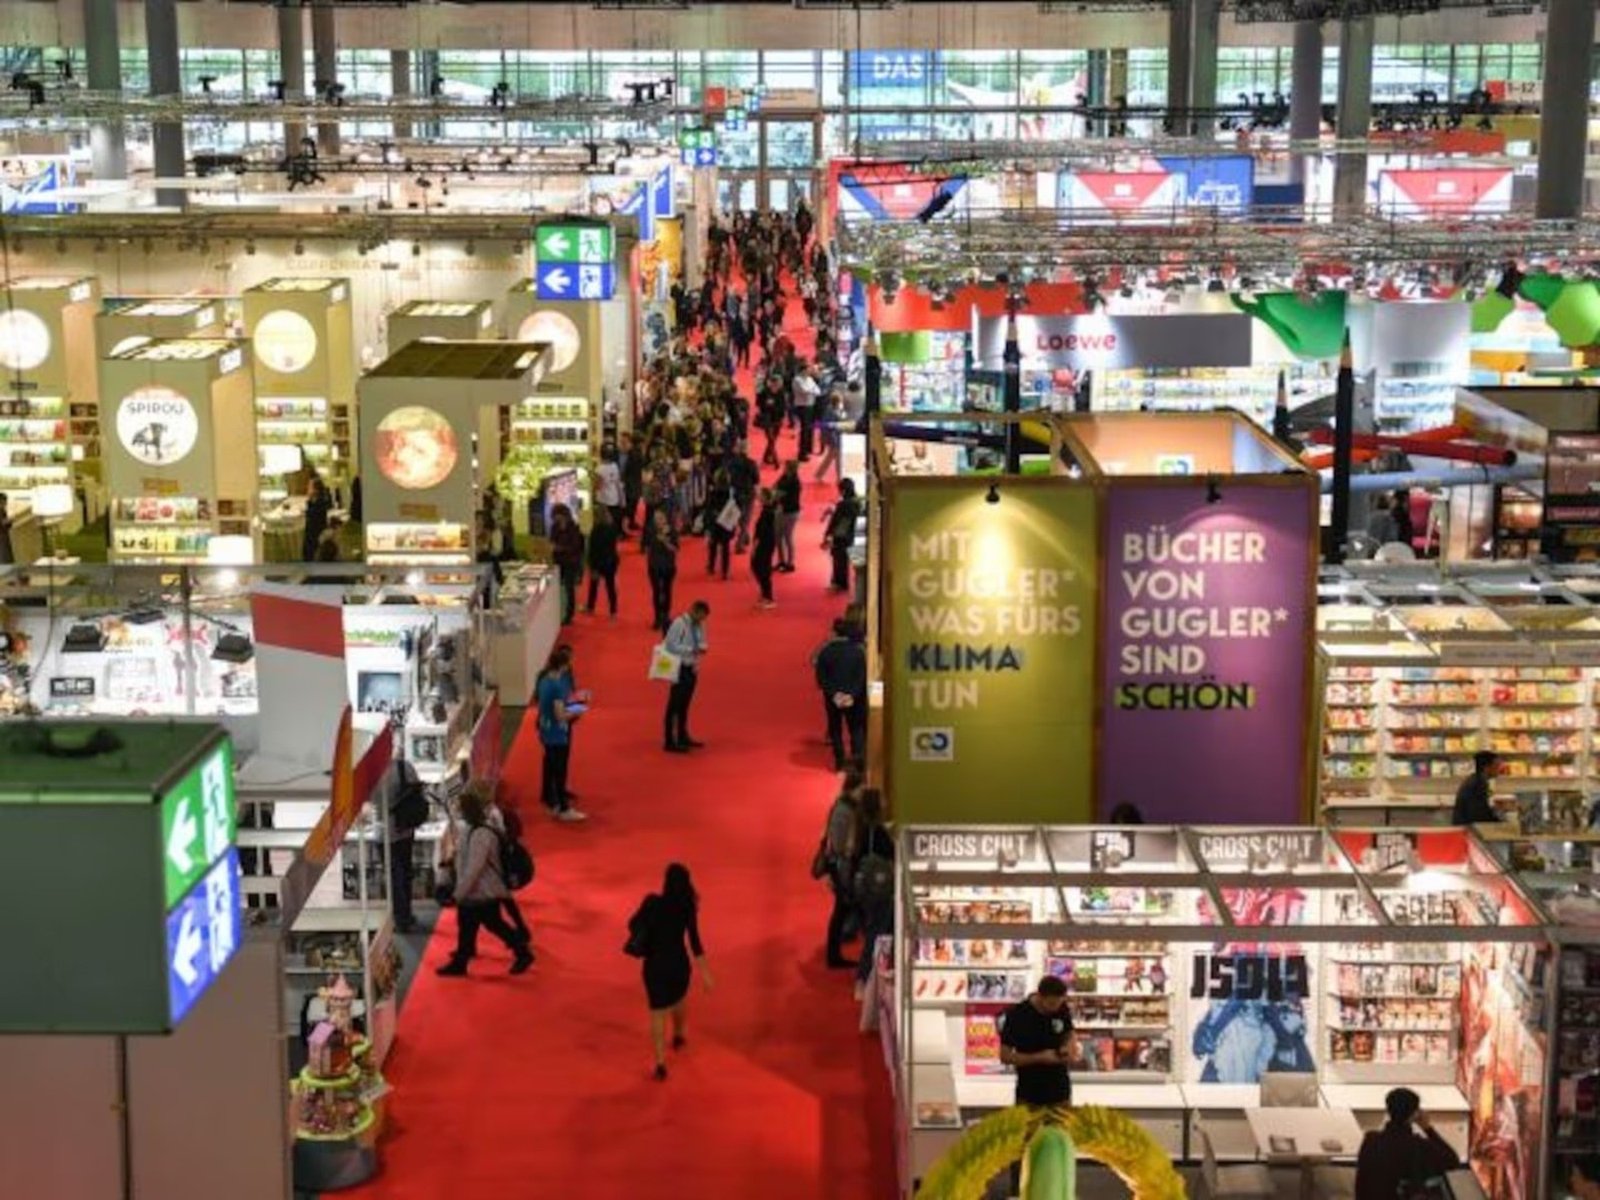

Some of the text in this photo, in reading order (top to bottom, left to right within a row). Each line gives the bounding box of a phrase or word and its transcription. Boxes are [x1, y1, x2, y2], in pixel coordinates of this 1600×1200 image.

[873, 54, 924, 79] DAS
[126, 401, 184, 415] SPIROU
[909, 531, 971, 561] MIT
[1123, 525, 1266, 563] BÜCHER
[1121, 570, 1205, 600] VON
[908, 597, 1081, 636] WAS FÜRS
[909, 643, 1020, 671] KLIMA
[1120, 644, 1206, 675] SIND
[909, 679, 979, 709] TUN
[1119, 675, 1250, 711] SCHÖN
[914, 834, 977, 857] CROSS
[1200, 835, 1261, 858] CROSS
